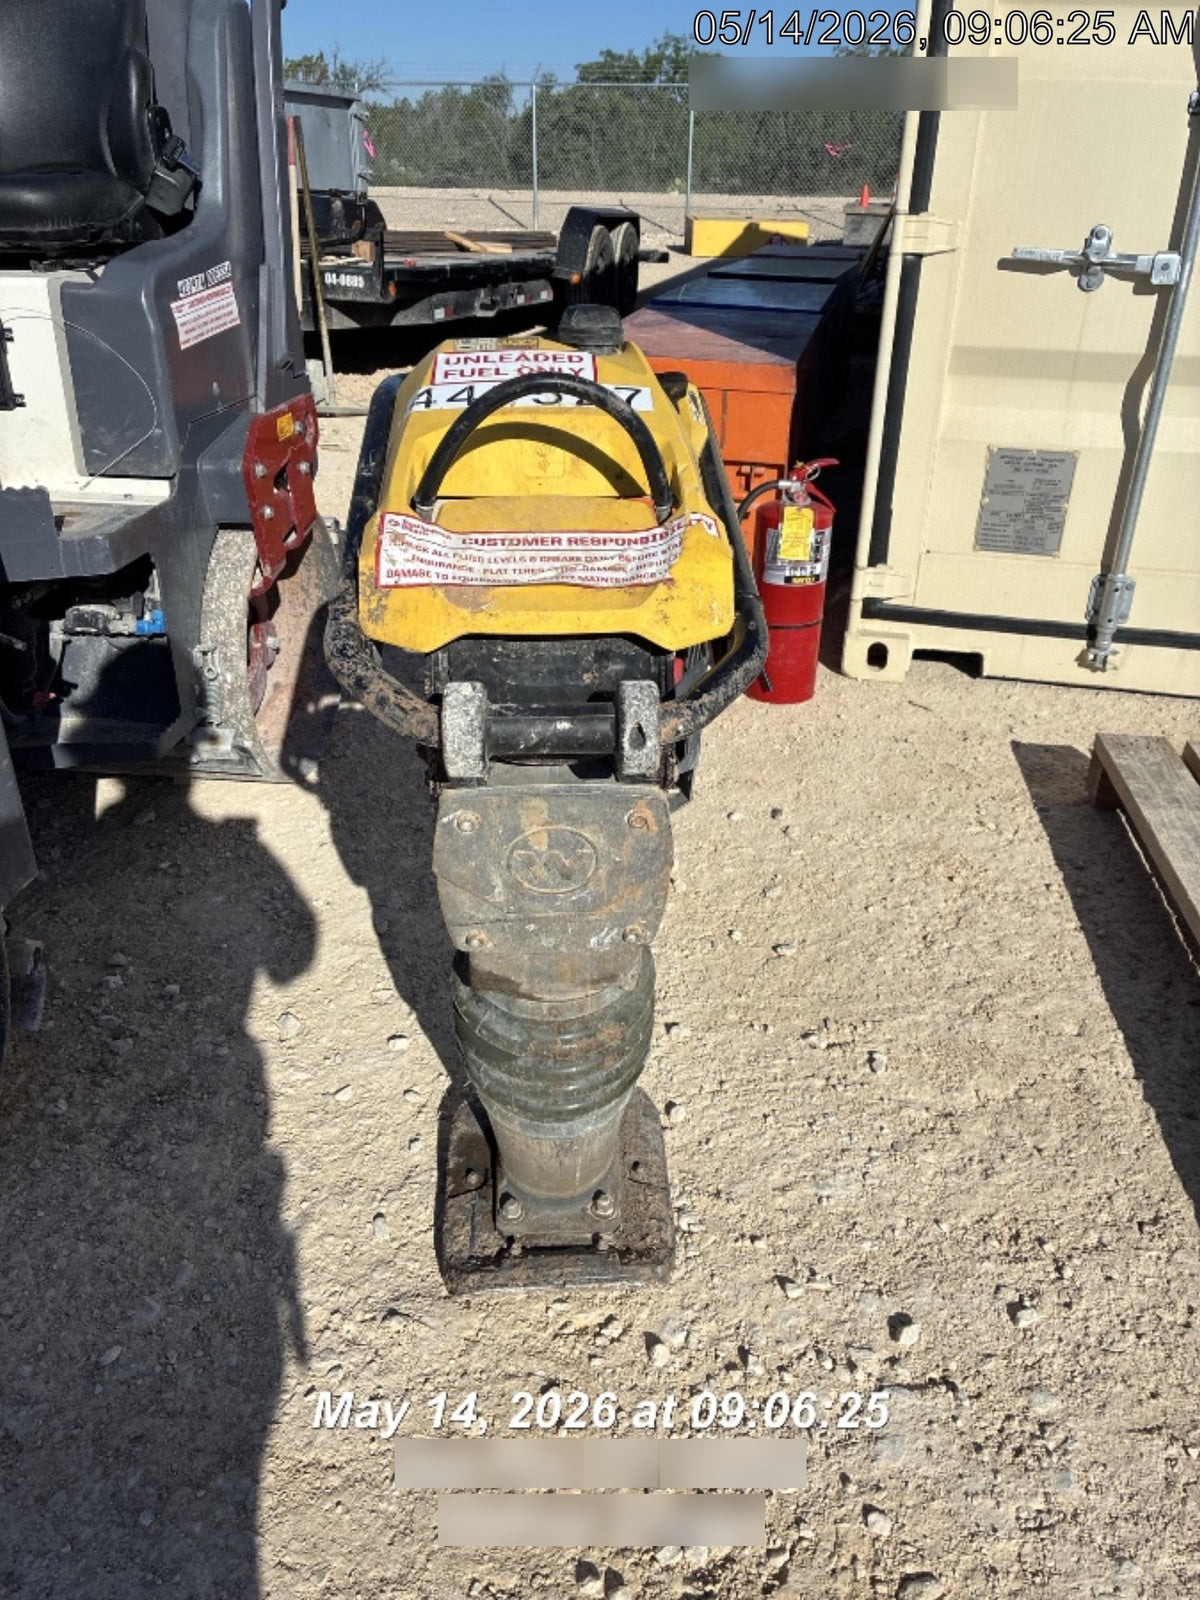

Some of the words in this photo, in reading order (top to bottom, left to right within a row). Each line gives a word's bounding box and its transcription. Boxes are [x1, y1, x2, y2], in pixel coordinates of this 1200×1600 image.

[444, 352, 584, 365] UNLEADED
[443, 367, 508, 379] FUEL
[462, 537, 562, 547] CUSTOMER
